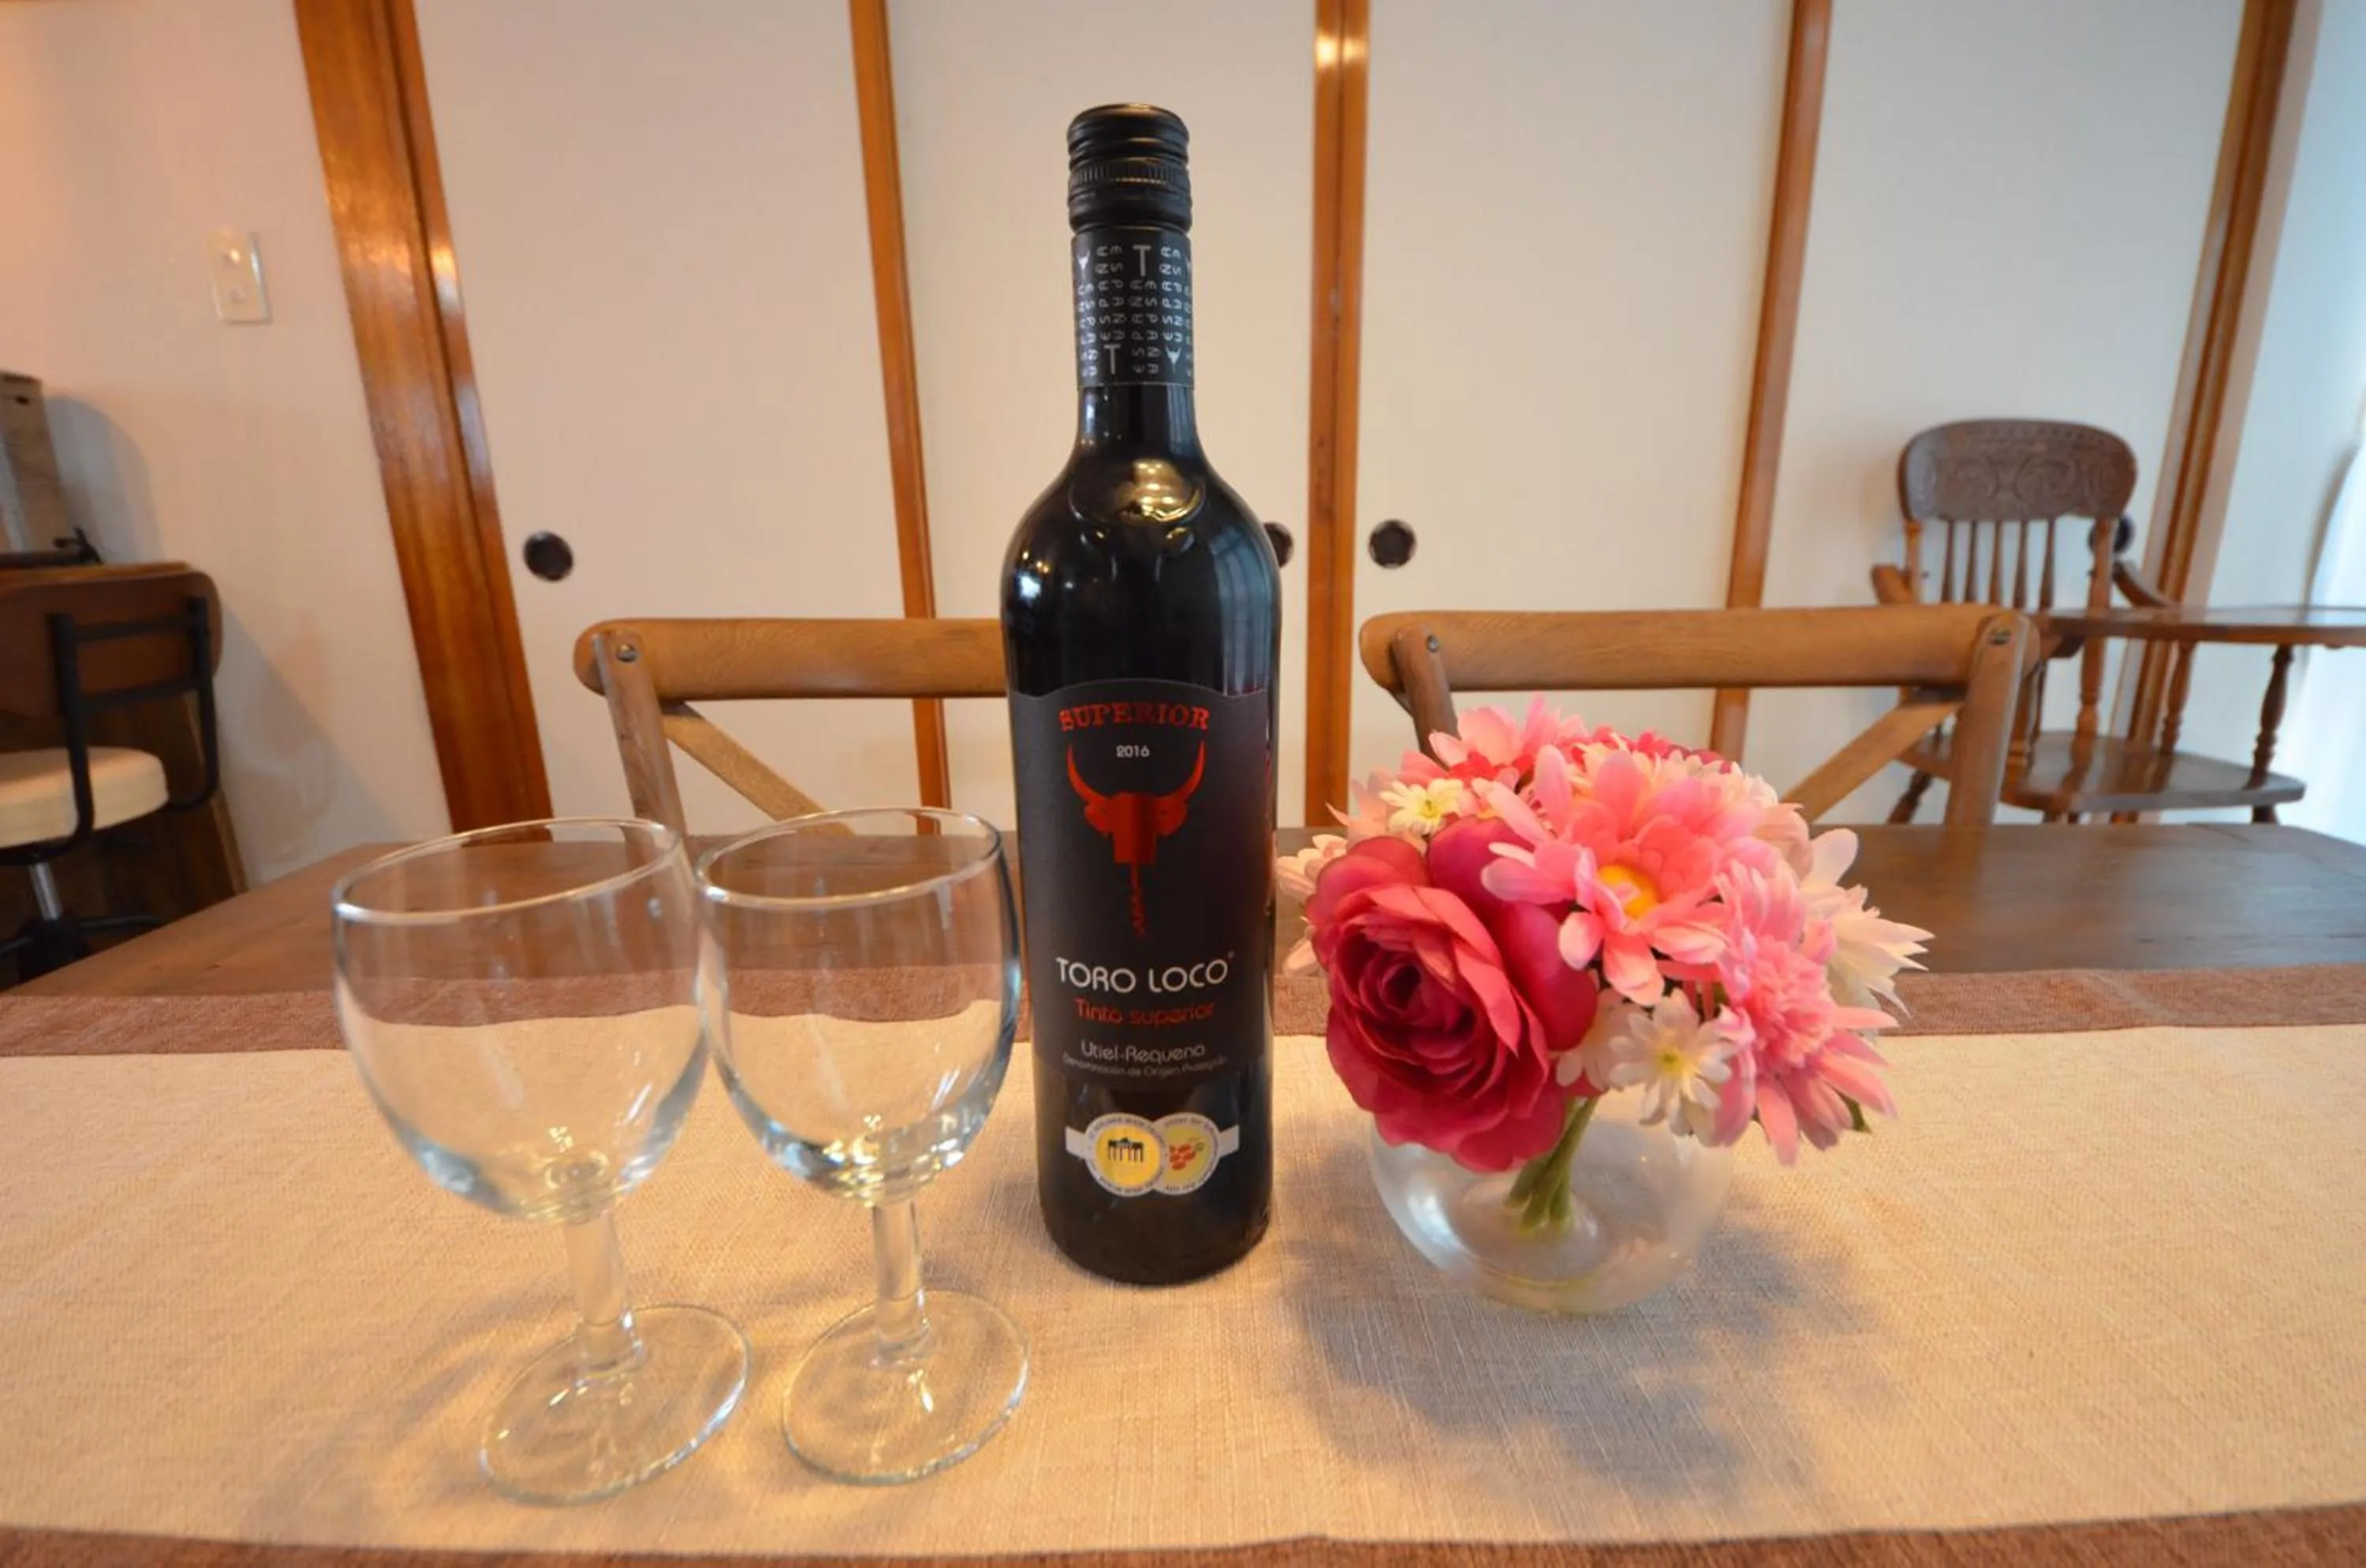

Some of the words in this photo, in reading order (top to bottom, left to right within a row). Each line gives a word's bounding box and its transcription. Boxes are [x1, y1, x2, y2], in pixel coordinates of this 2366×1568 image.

[1058, 701, 1211, 732] SUPERIOR
[1116, 745, 1151, 759] 2016
[1055, 956, 1136, 994] TORO
[1148, 958, 1228, 993] LOCO
[1073, 996, 1123, 1025] Tinto
[1129, 1002, 1215, 1027] superior
